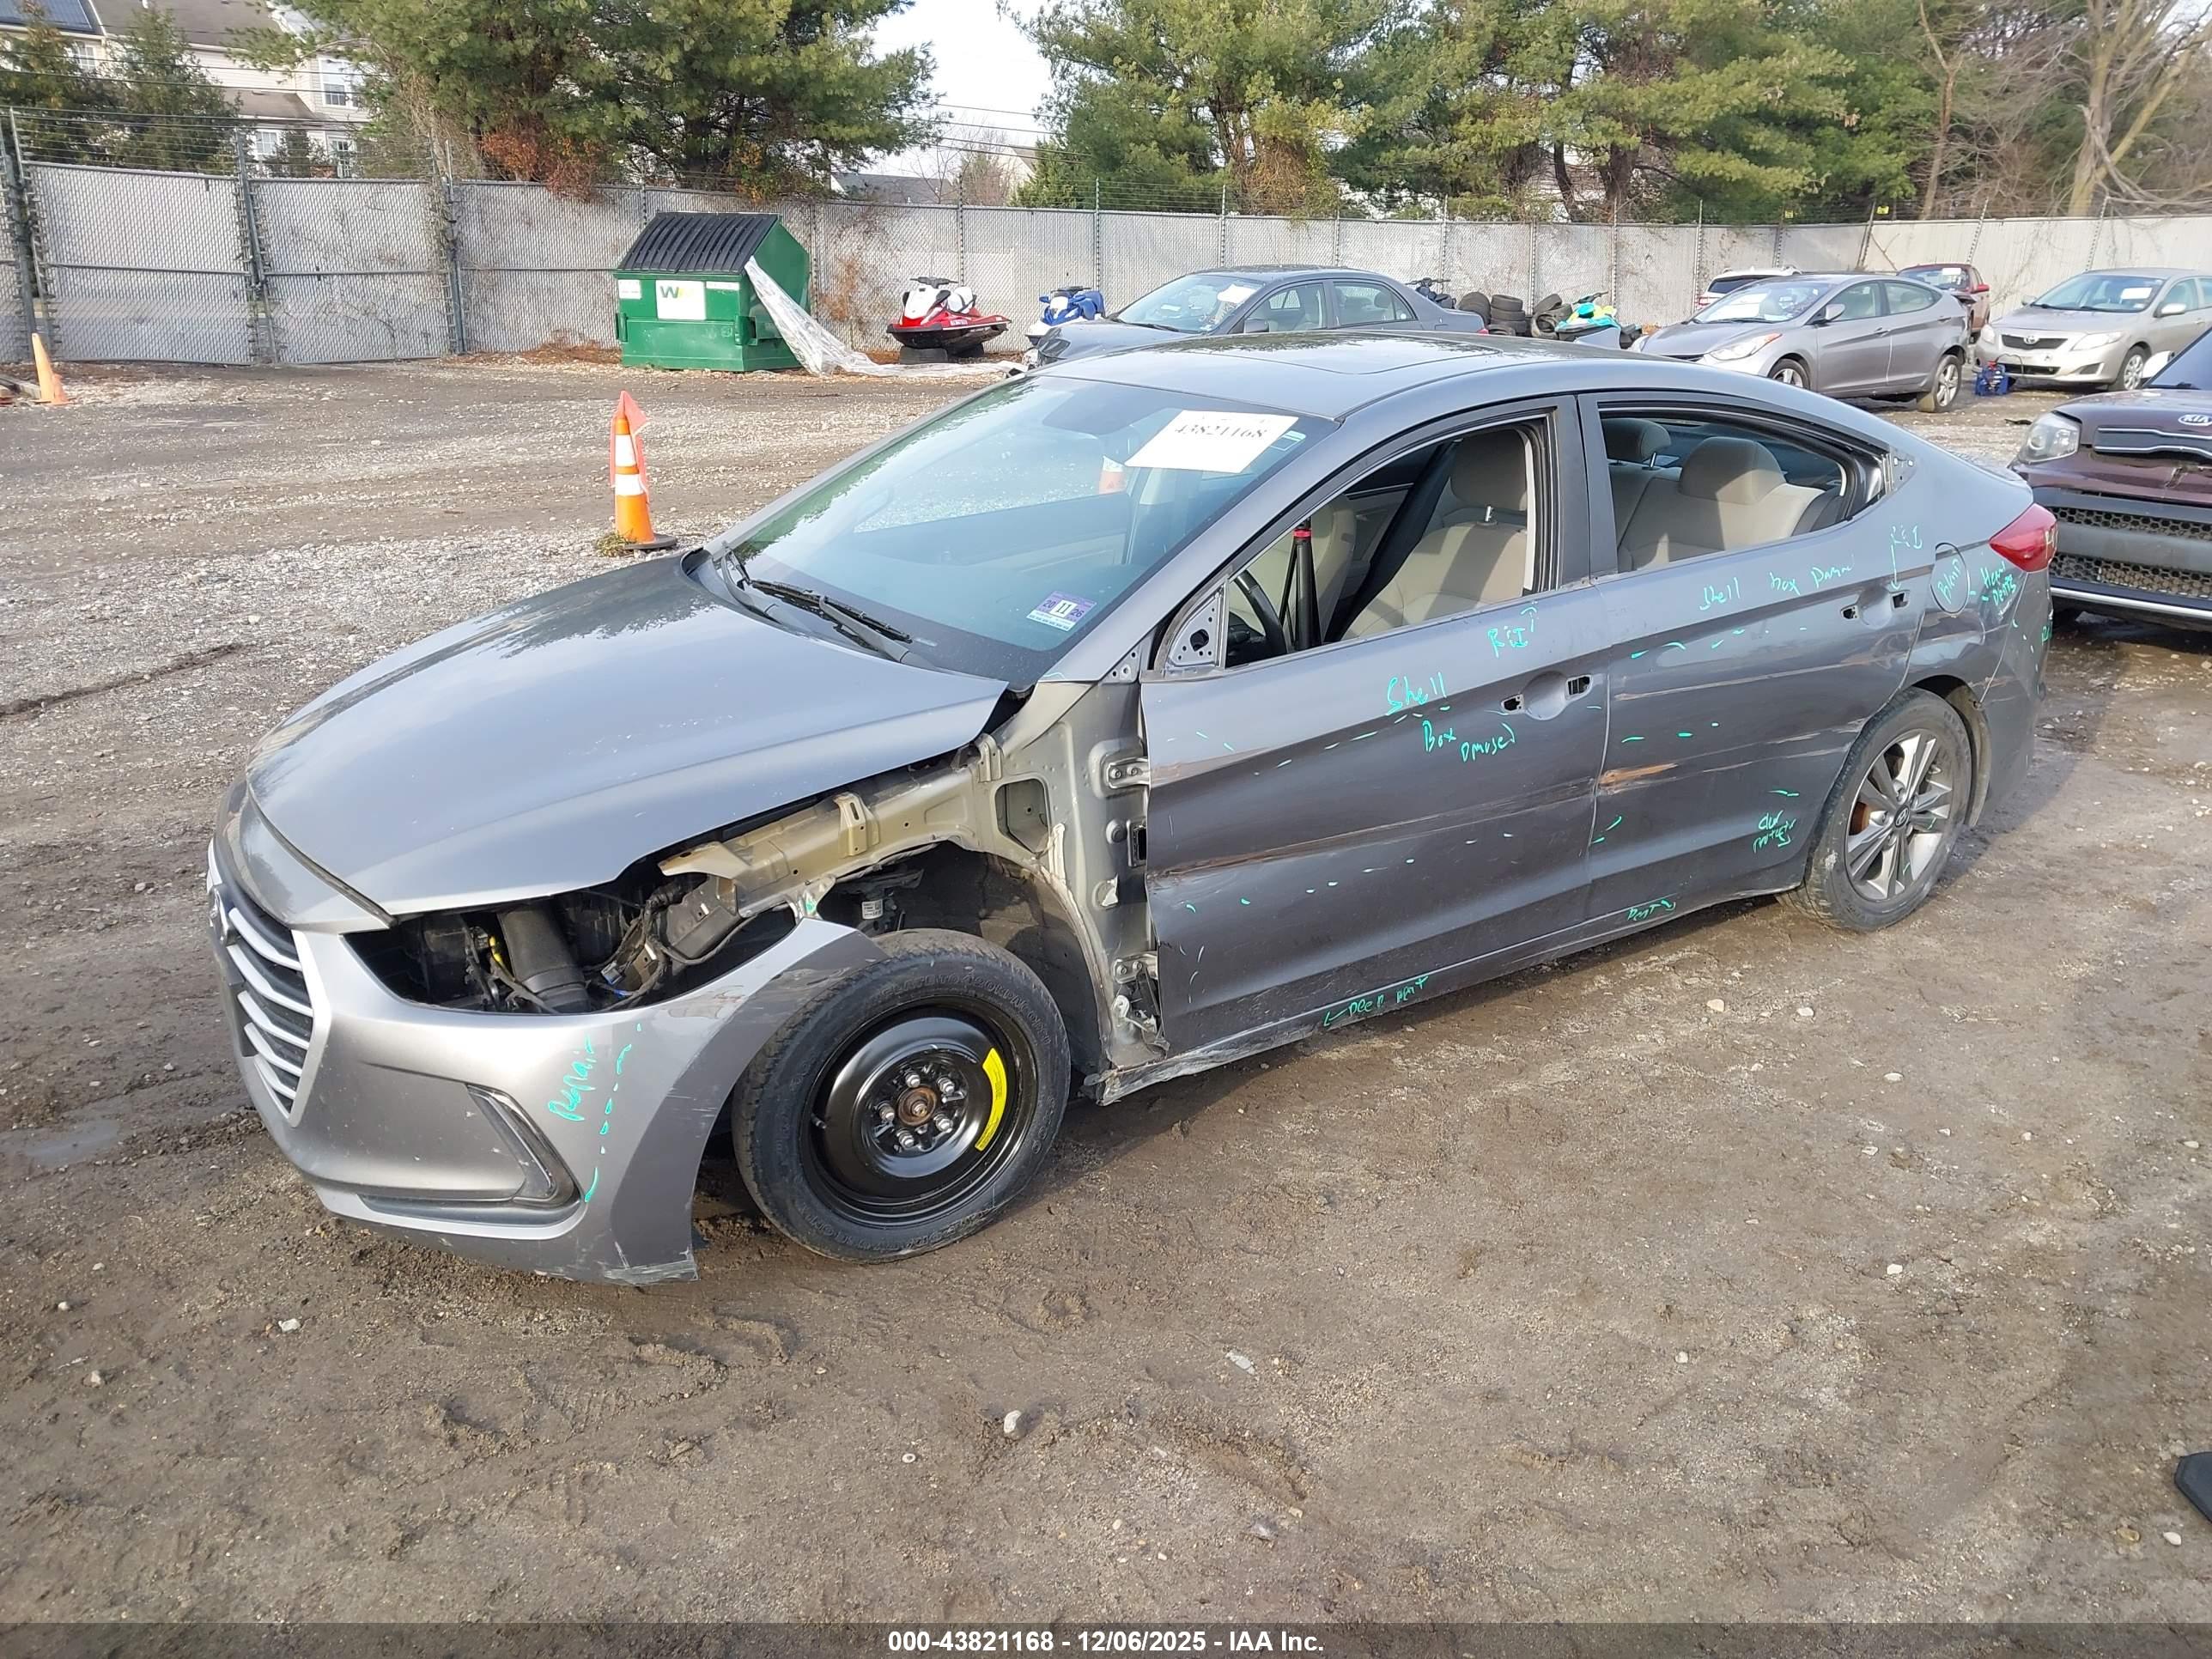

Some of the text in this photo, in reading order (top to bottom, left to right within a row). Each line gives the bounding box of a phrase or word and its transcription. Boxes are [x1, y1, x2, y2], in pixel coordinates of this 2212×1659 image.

[2184, 414, 2209, 423] KIA
[1385, 672, 1448, 715] Shell
[1422, 720, 1456, 752] Box
